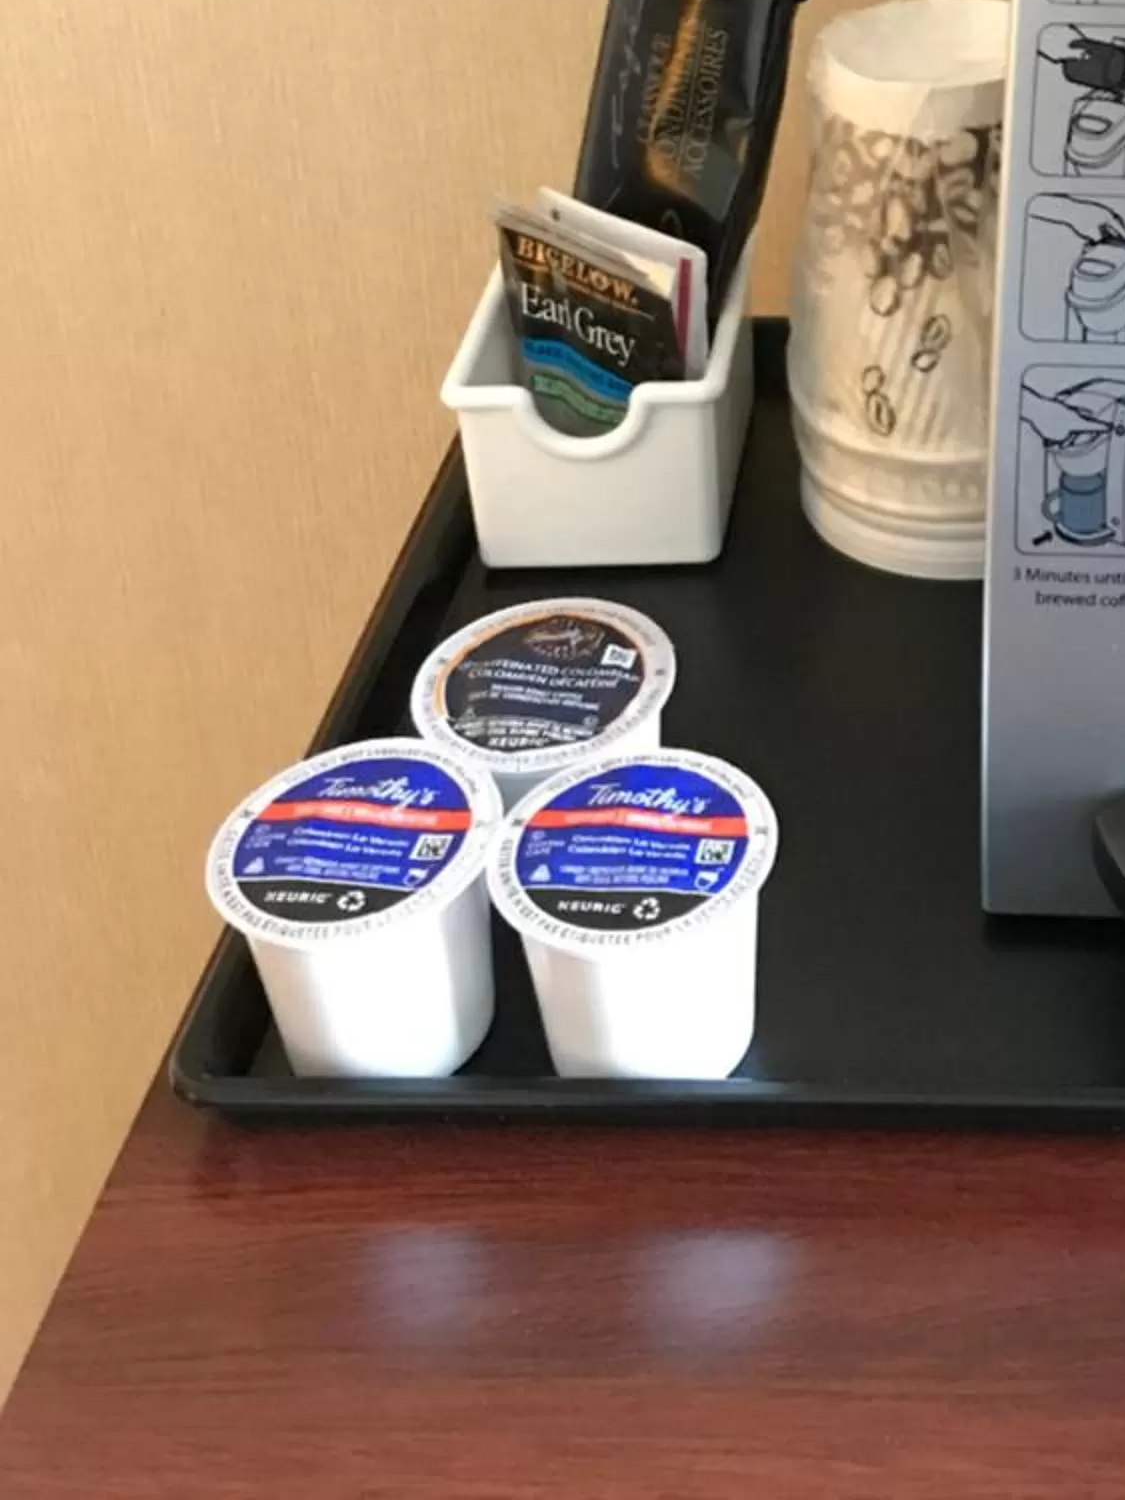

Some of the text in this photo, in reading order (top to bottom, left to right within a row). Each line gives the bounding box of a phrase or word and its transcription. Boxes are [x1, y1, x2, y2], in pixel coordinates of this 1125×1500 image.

[520, 283, 572, 331] Earl
[574, 307, 636, 367] Grey
[1025, 568, 1090, 584] Minutes
[1035, 590, 1097, 607] brewed
[587, 783, 711, 815] Timothy's
[264, 890, 330, 905] KEURIG
[557, 900, 625, 914] KEURIG
